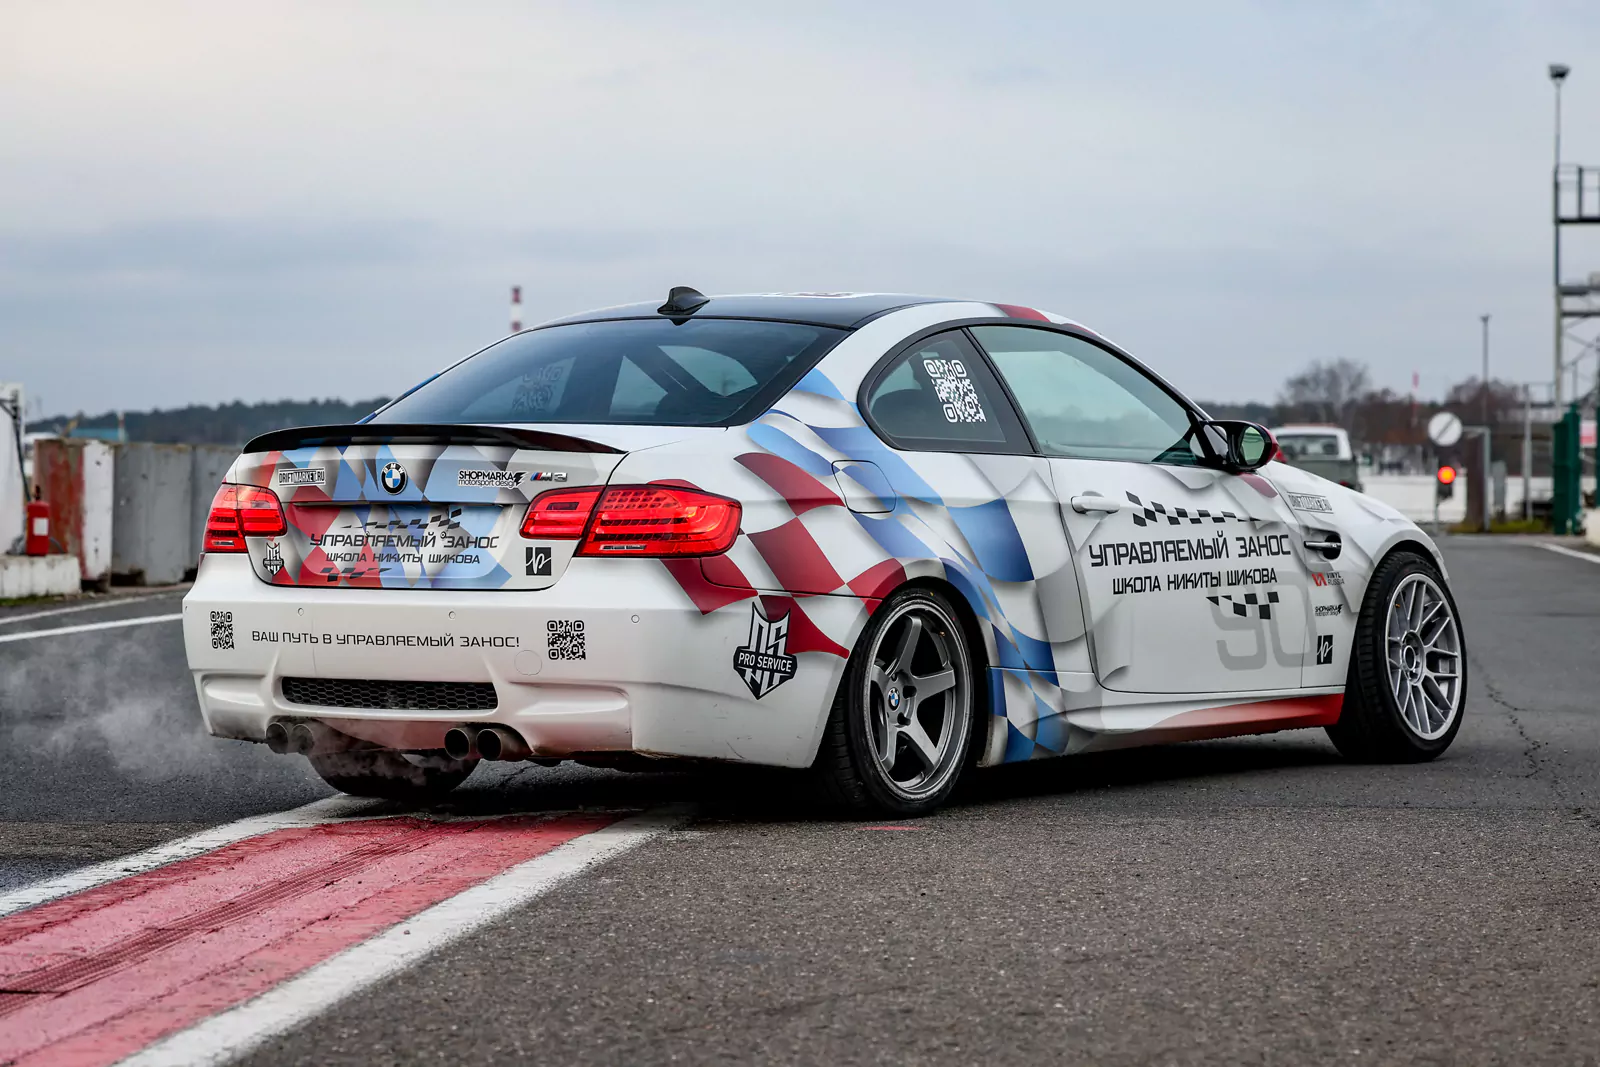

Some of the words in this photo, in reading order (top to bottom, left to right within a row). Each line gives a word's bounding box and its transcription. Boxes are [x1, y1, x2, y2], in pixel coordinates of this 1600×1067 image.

[458, 479, 494, 487] motorsport
[459, 470, 514, 480] SHOPMARKA
[310, 532, 437, 548] УПРАВЛЯЕМЫЙ
[443, 535, 500, 549] ЗАНОС
[1089, 530, 1229, 567] УПРАВЛЯЕМЫЙ
[1235, 534, 1291, 558] ЗАНОС
[325, 552, 367, 562] ШКОЛА
[373, 553, 423, 563] НИКИТЫ
[428, 554, 480, 564] ШИКОВА
[1112, 575, 1161, 595] ШКОЛА
[1167, 571, 1221, 591] НИКИТЫ
[1227, 567, 1278, 586] ШИКОВА
[252, 630, 279, 643] ВАШ
[283, 632, 319, 644] ПУТЬ
[322, 634, 332, 645] В
[336, 633, 454, 647] УПРАВЛЯЕМЫЙ
[460, 636, 520, 648] ЗАНОС!
[738, 652, 756, 666] PRO
[757, 656, 793, 672] SERVICE
